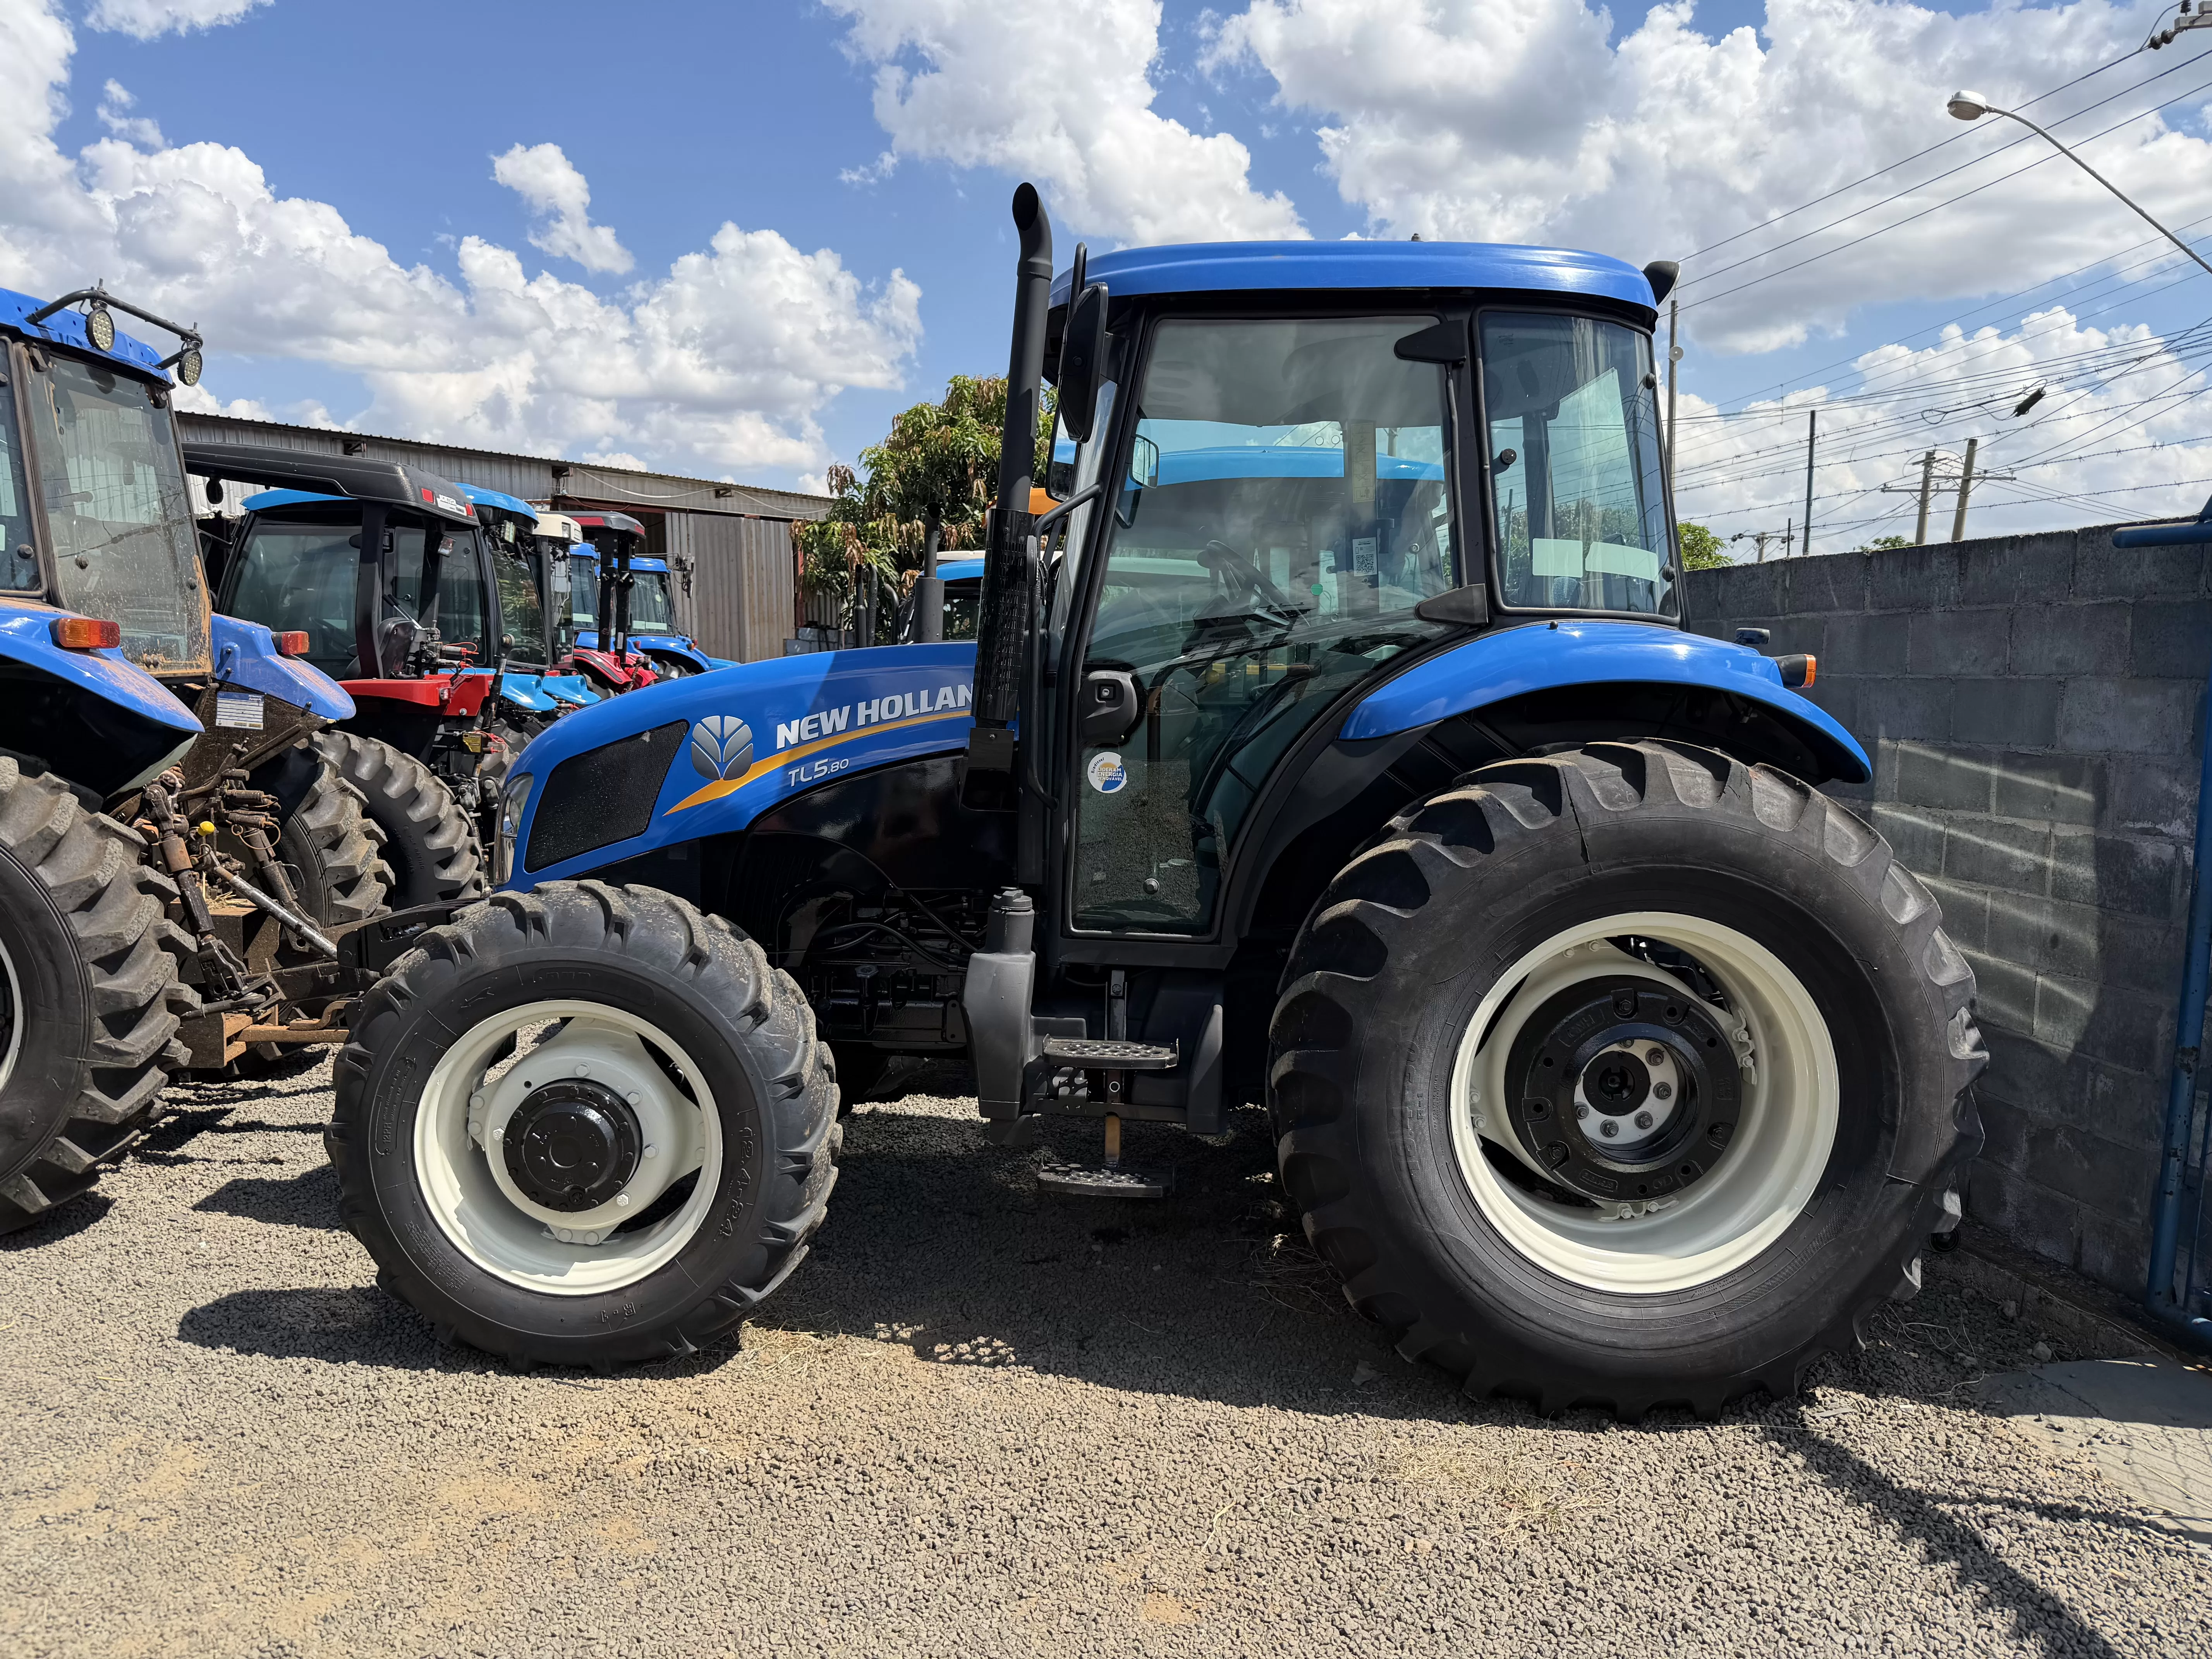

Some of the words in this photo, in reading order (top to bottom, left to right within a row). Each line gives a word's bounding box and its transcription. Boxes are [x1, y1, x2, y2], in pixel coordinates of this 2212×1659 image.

[776, 705, 850, 749] NEW
[857, 684, 973, 726] HOLLAN
[719, 1127, 753, 1237] 12.4-24
